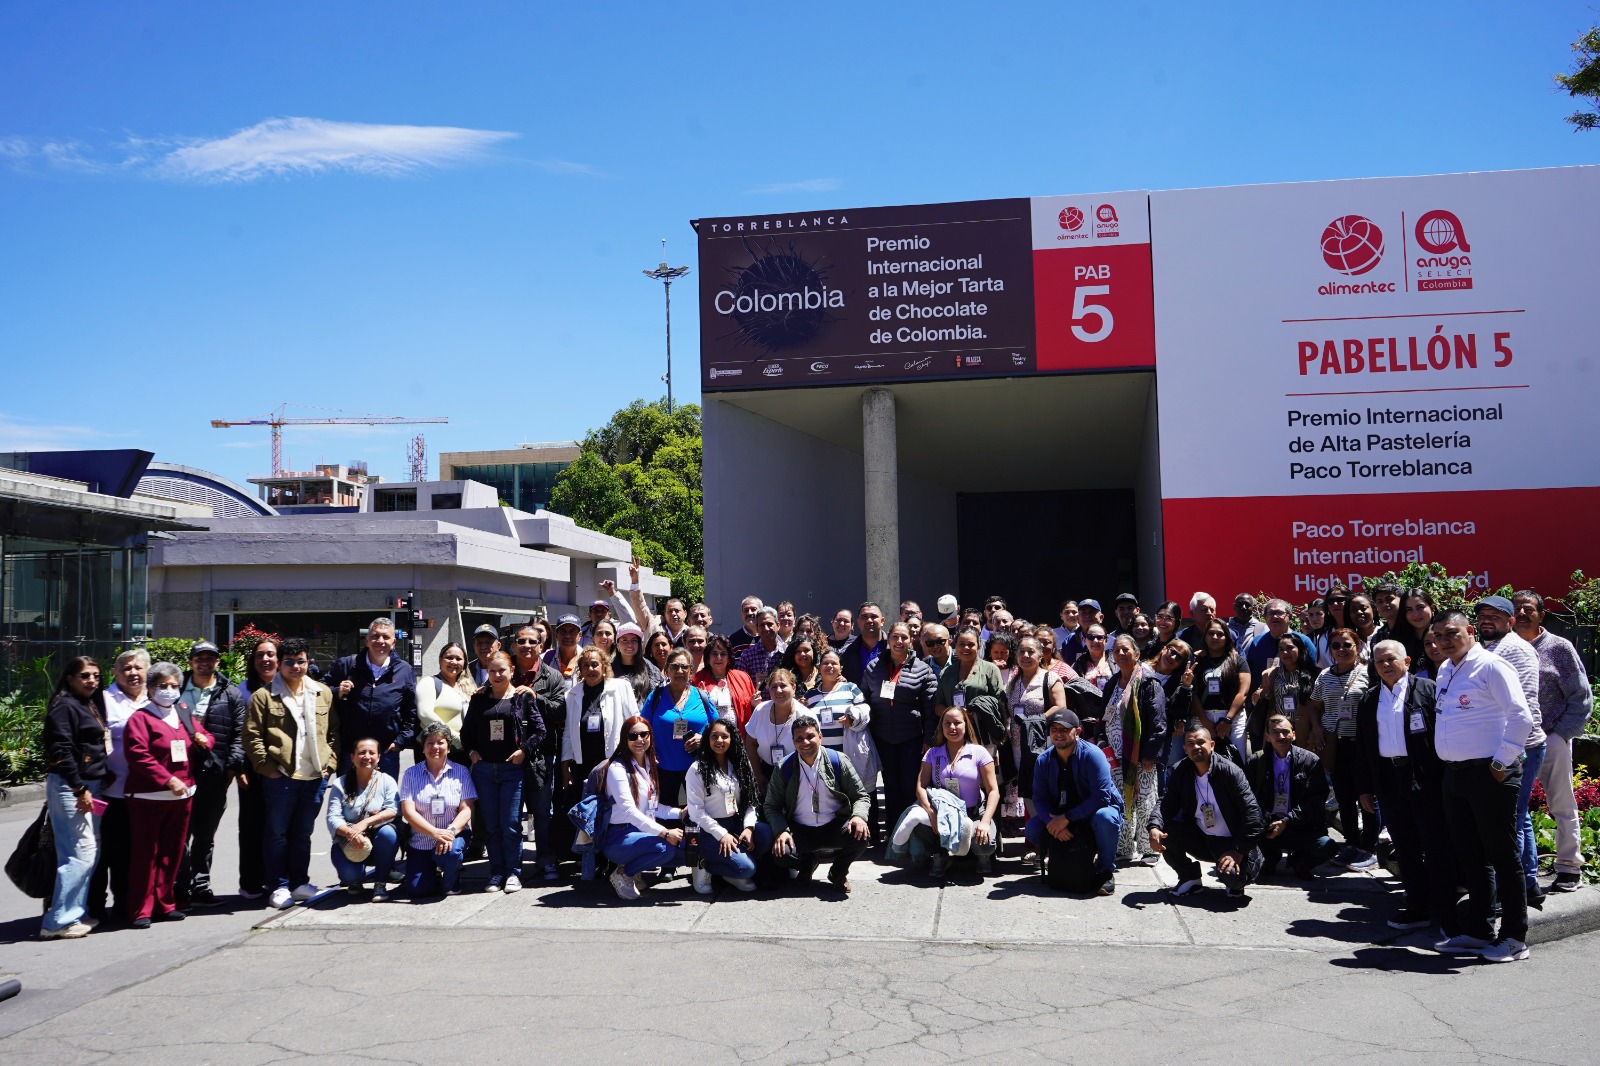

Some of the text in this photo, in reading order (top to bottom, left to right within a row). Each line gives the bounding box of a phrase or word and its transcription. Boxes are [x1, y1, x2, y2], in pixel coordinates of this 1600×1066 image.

[711, 216, 849, 232] TORREBLANCA
[867, 235, 931, 252] Premio
[868, 254, 983, 275] Internacional
[1416, 256, 1471, 269] anuga
[1075, 265, 1111, 280] PAB
[1417, 269, 1472, 277] SELECT
[868, 278, 1004, 298] a la Mejor Tarta
[1317, 282, 1396, 295] alimentec
[1422, 280, 1467, 289] Colombia
[715, 283, 844, 314] Colombia
[869, 302, 987, 320] de Chocolate
[1071, 285, 1113, 342] 5
[870, 325, 987, 343] de Colombia.
[1298, 325, 1513, 375] PABELLÓN 5
[1288, 403, 1503, 426] Premio Internacional
[1289, 431, 1470, 453] de Alta Pastelería
[1291, 459, 1472, 479] Paco Torreblanca
[1293, 519, 1475, 538] Paco Torreblanca
[1294, 546, 1424, 564] International
